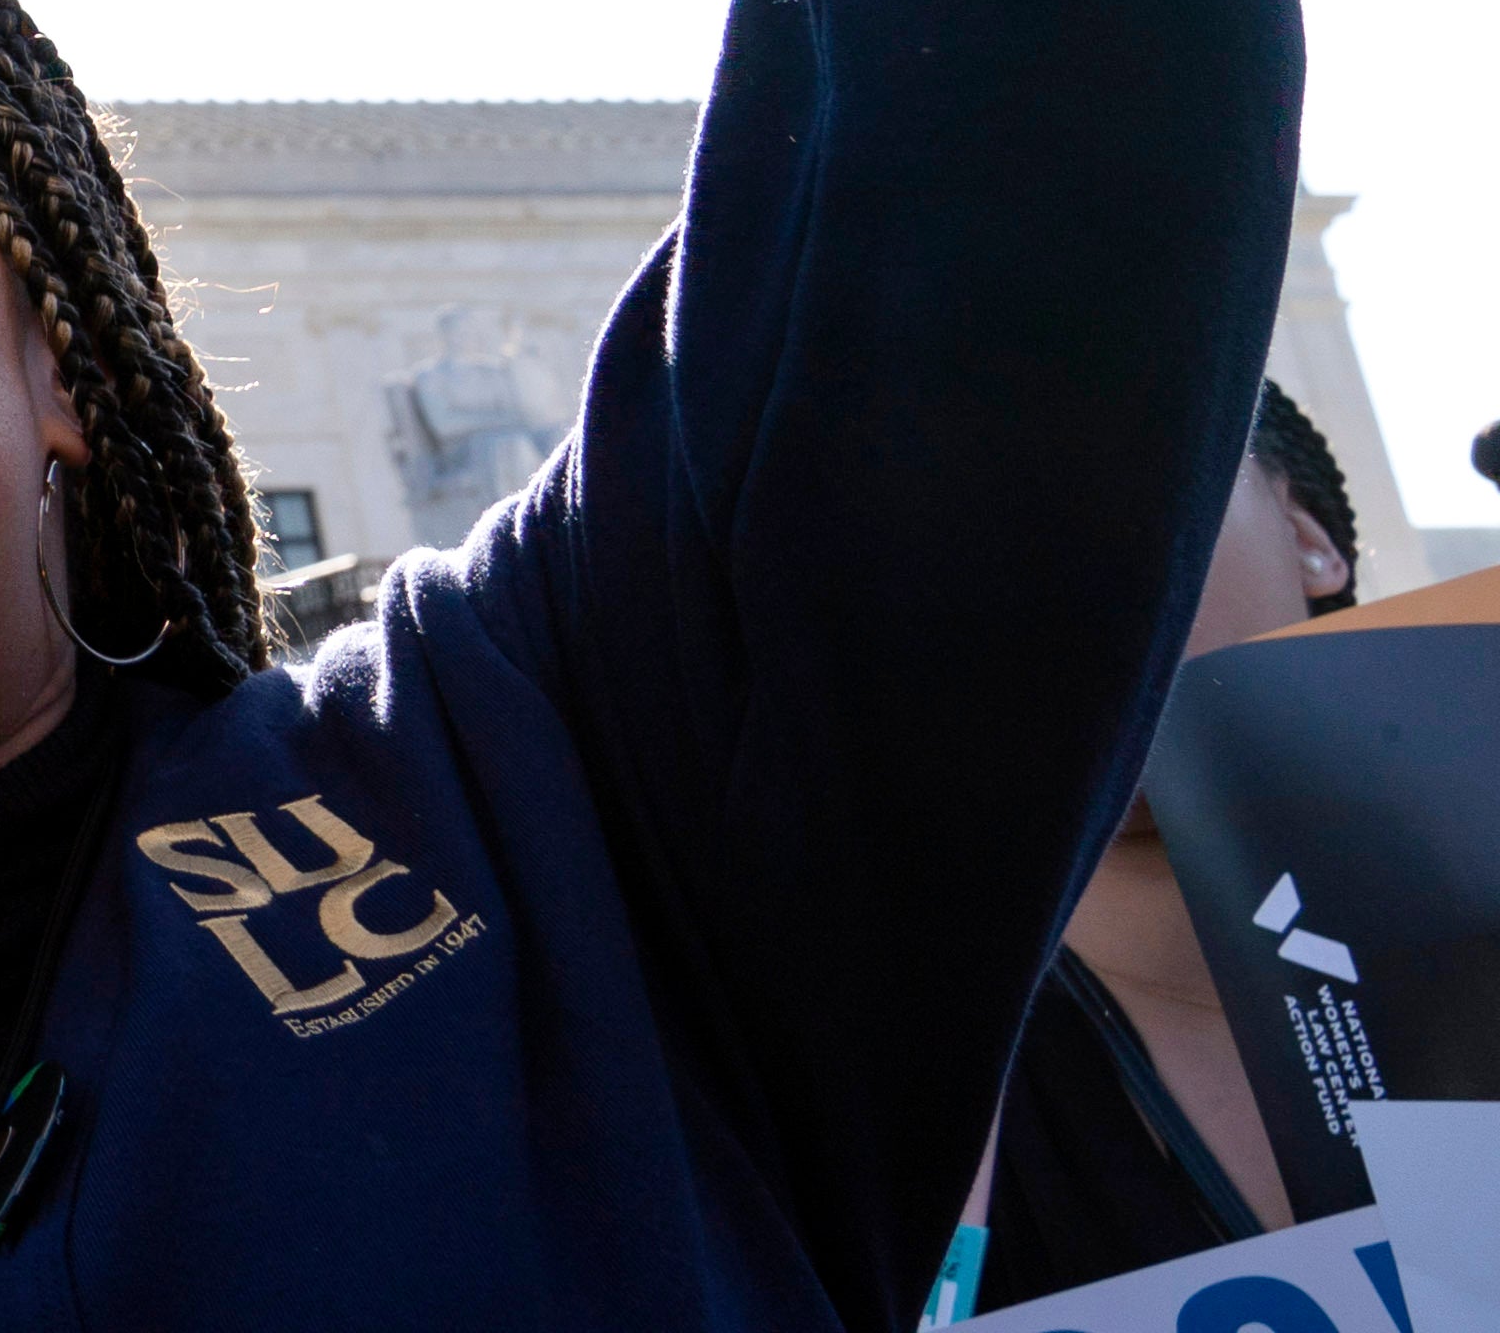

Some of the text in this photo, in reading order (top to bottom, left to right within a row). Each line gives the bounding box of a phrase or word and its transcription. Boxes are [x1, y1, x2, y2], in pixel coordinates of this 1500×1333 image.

[435, 913, 487, 956] 1947
[1284, 994, 1341, 1135] ACTION FUND
[1307, 1009, 1333, 1056] LAW
[1318, 984, 1363, 1090] WOMEN'S
[1341, 1000, 1386, 1099] NATIONA
